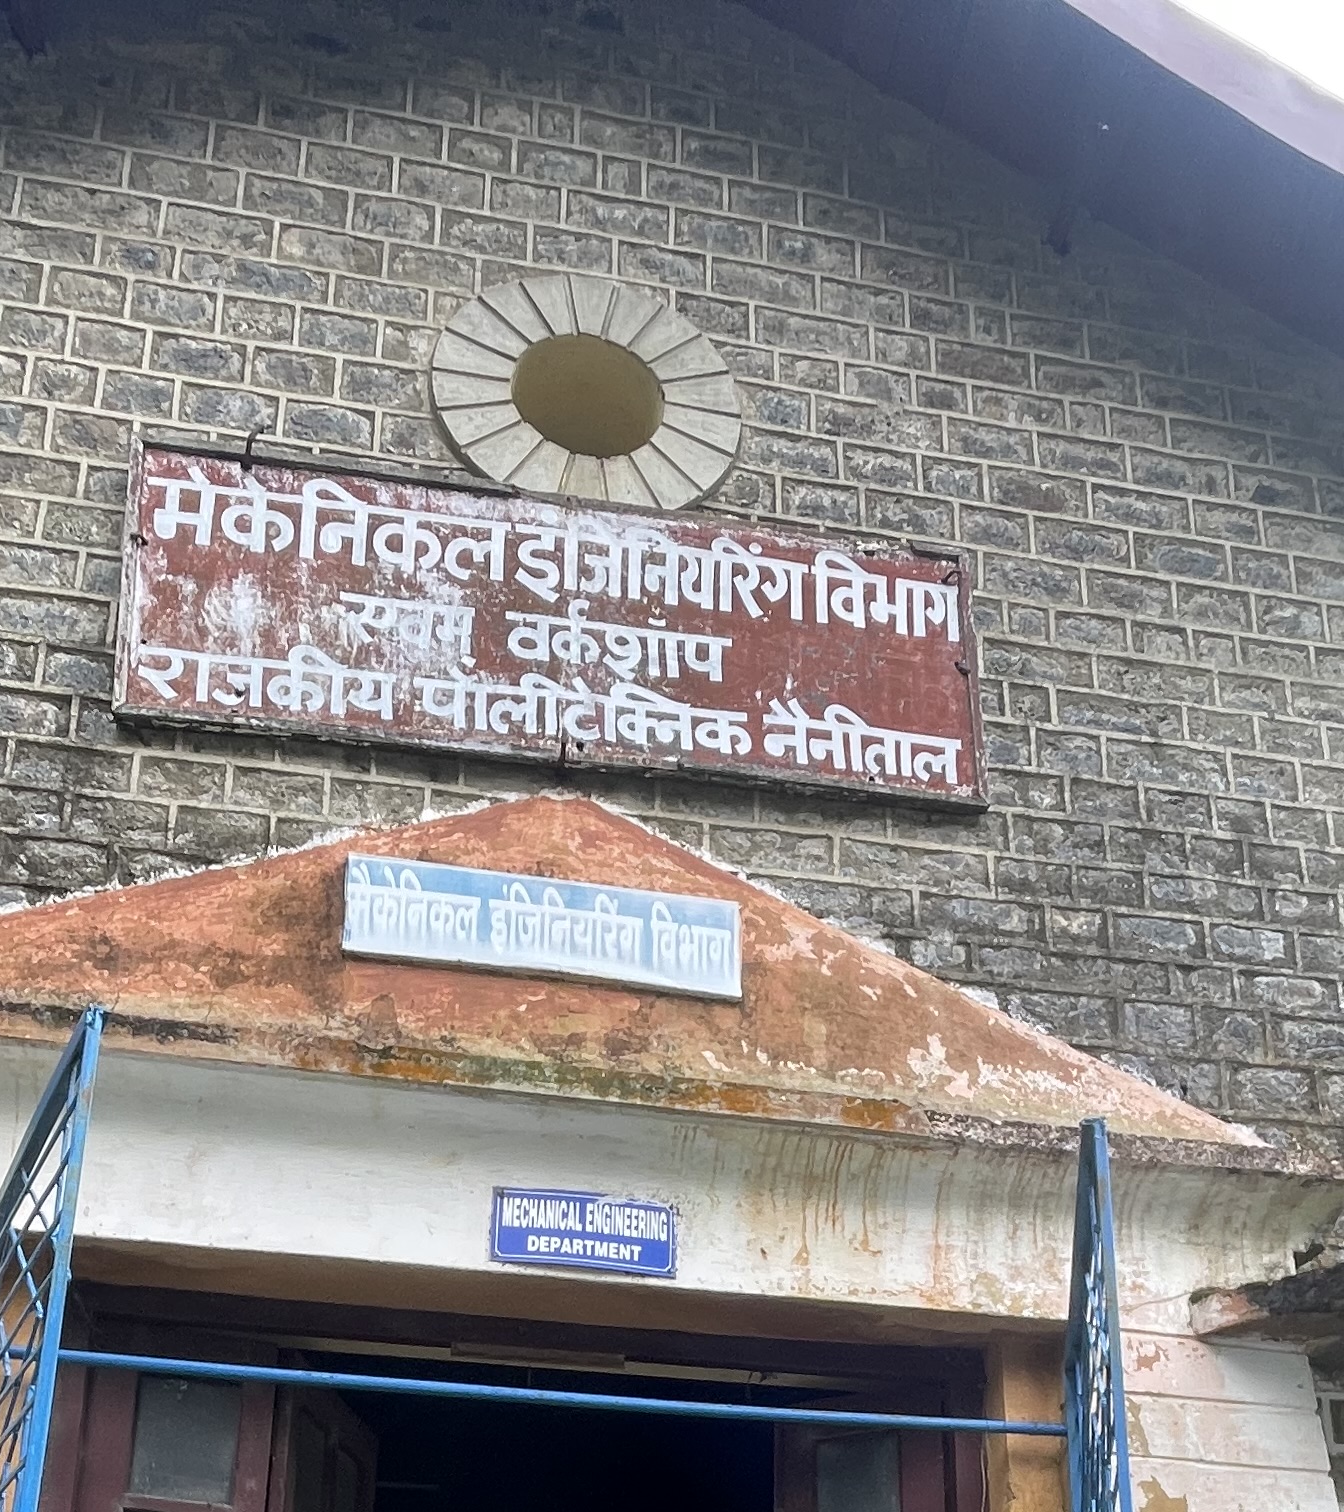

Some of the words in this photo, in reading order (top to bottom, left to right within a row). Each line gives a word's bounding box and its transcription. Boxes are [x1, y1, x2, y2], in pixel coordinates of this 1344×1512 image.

[147, 466, 511, 582] मेकेनिकल
[810, 549, 960, 643] विभाग
[505, 599, 732, 683] वर्कशॉप
[136, 644, 397, 720] राजकीय
[762, 697, 962, 785] नैनीताल
[651, 901, 731, 980] विभाग
[502, 1197, 582, 1232] MECHANICAL
[586, 1203, 668, 1242] ENGINEERING
[527, 1235, 642, 1262] DEPARTMENT
